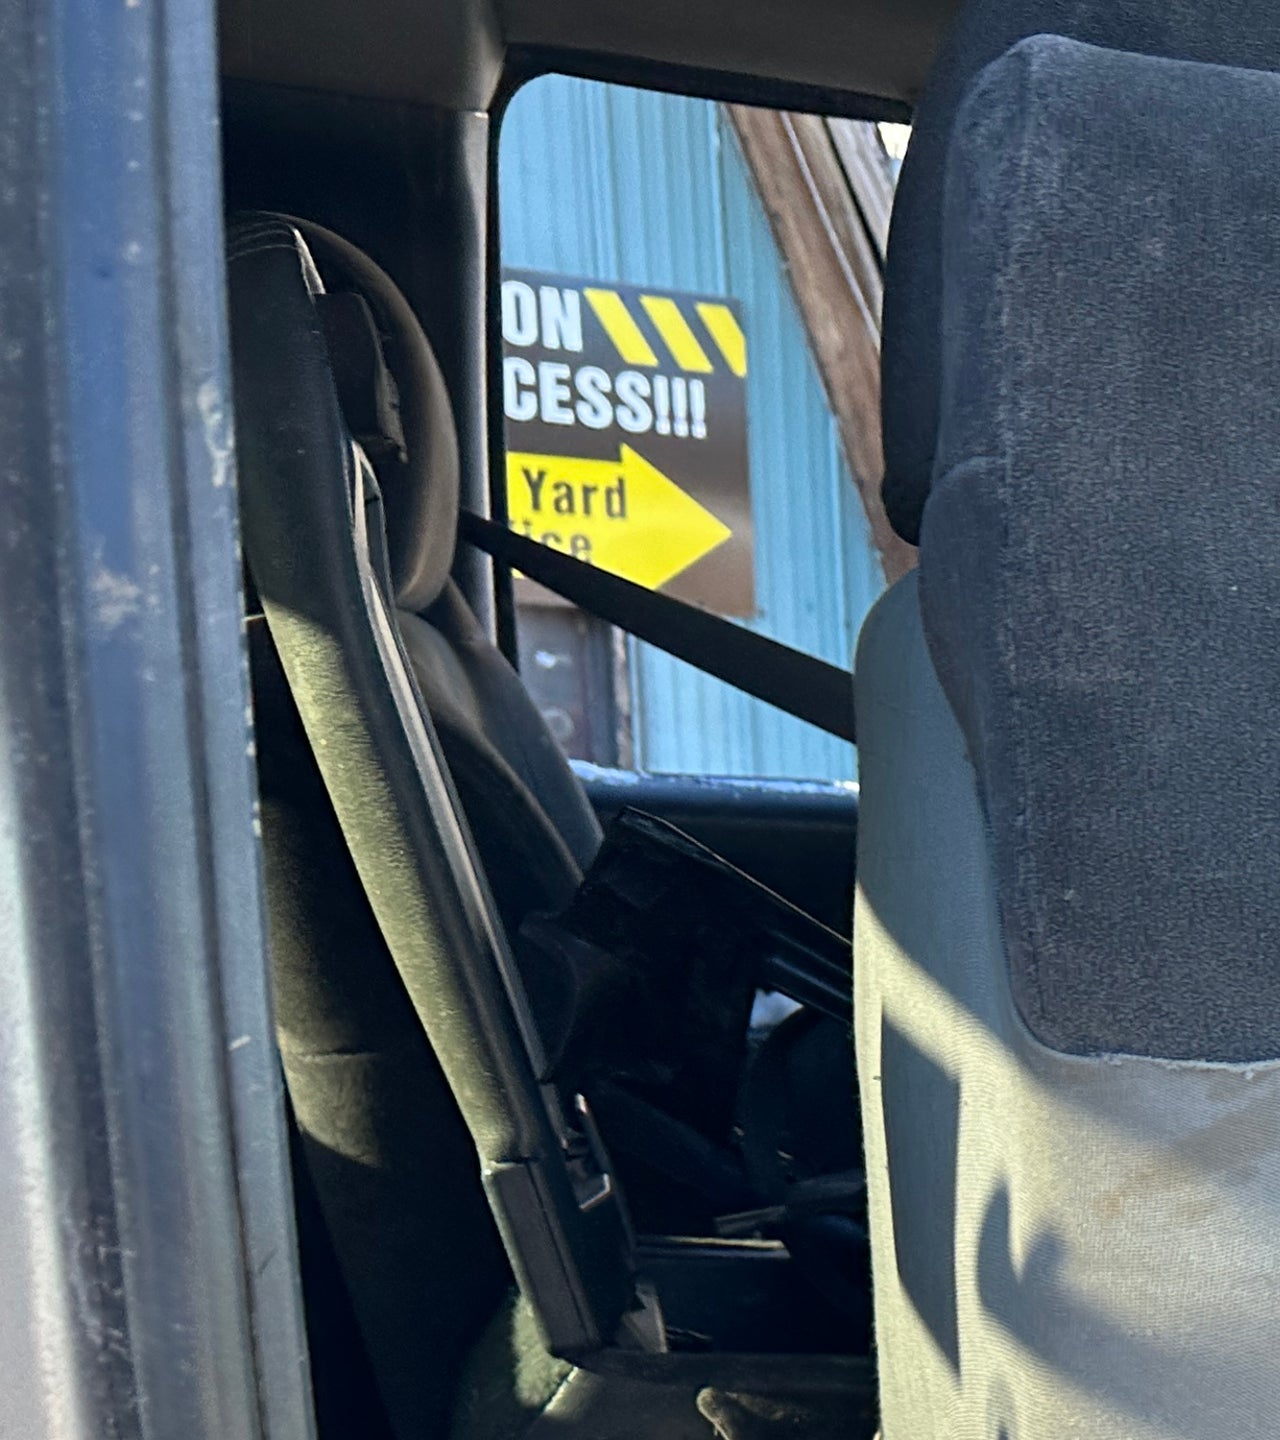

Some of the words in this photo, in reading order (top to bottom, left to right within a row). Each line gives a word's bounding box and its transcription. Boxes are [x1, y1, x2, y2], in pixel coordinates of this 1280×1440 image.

[501, 280, 584, 352] ON
[503, 356, 708, 440] CESS!!!
[521, 466, 627, 518] Yard
